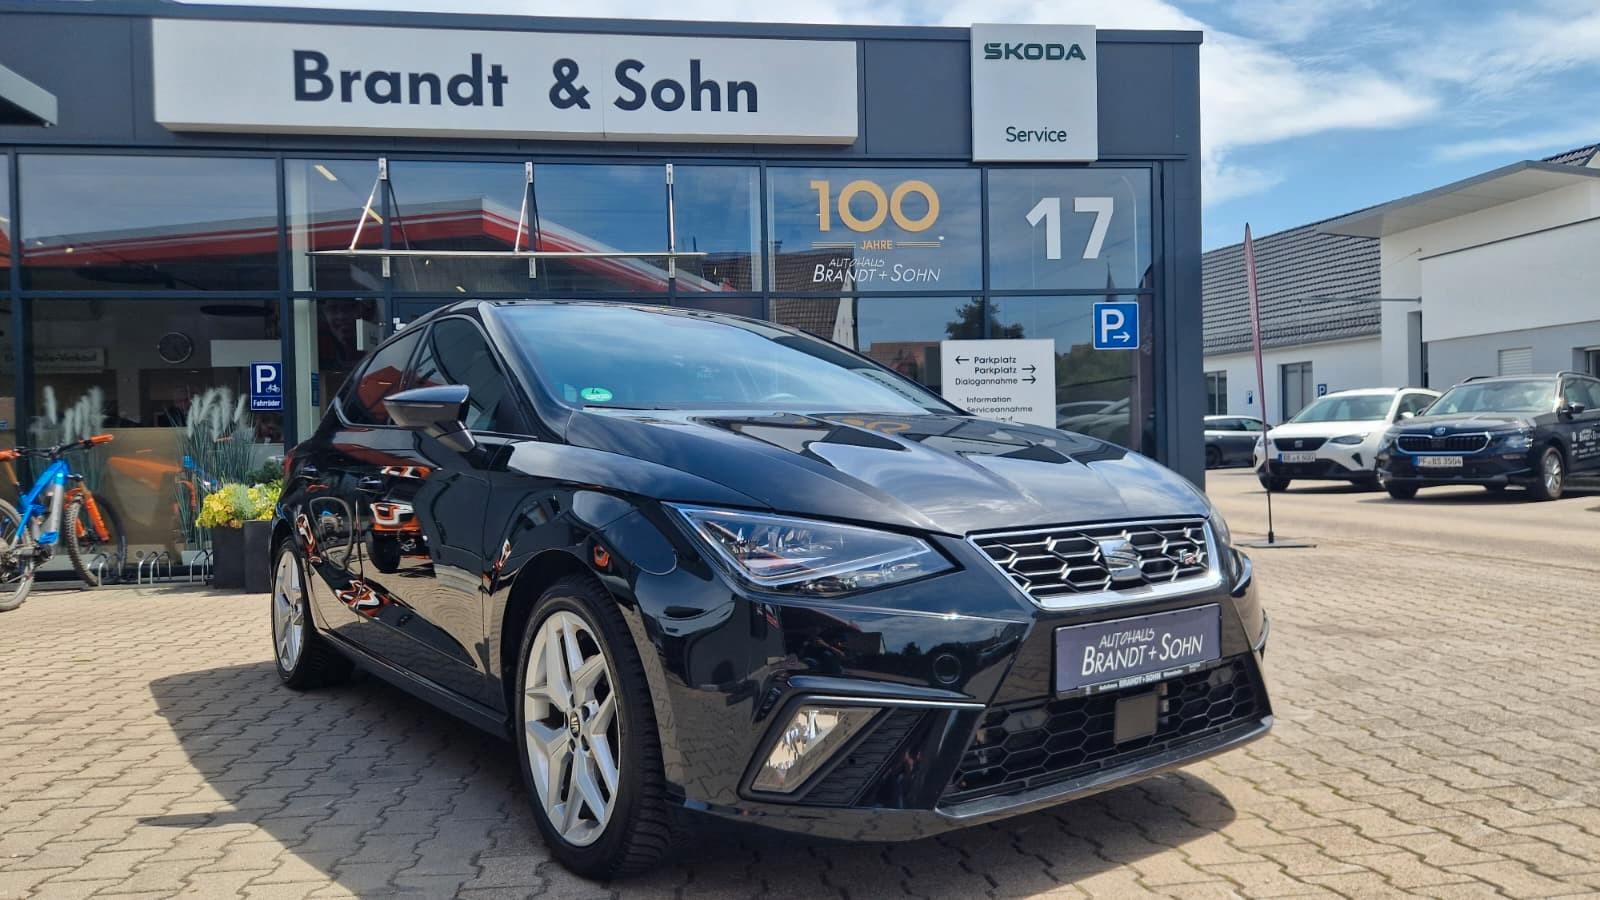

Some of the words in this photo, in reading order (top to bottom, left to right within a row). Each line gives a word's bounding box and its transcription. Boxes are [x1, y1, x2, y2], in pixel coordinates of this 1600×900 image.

[293, 49, 509, 107] Brandt
[548, 58, 591, 110] &
[613, 58, 758, 113] Sohn
[1005, 126, 1068, 143] Service
[810, 180, 940, 232] 100
[1025, 197, 1114, 260] 17
[861, 240, 893, 250] JAHRE
[829, 257, 886, 268] AUTOHAUS
[812, 263, 877, 283] BRANDT
[890, 263, 941, 282] SOHN
[1101, 309, 1124, 343] P
[974, 356, 1017, 366] Parkplatz
[256, 365, 277, 393] P
[974, 366, 1018, 376] Parkplatz
[955, 377, 1019, 387] Dialogannahme
[966, 396, 1013, 404] Information
[966, 405, 1033, 414] Serviceannahme
[1099, 628, 1155, 649] AUTOHAUS
[1082, 645, 1148, 677] BRANDT
[1159, 632, 1204, 661] SOHN
